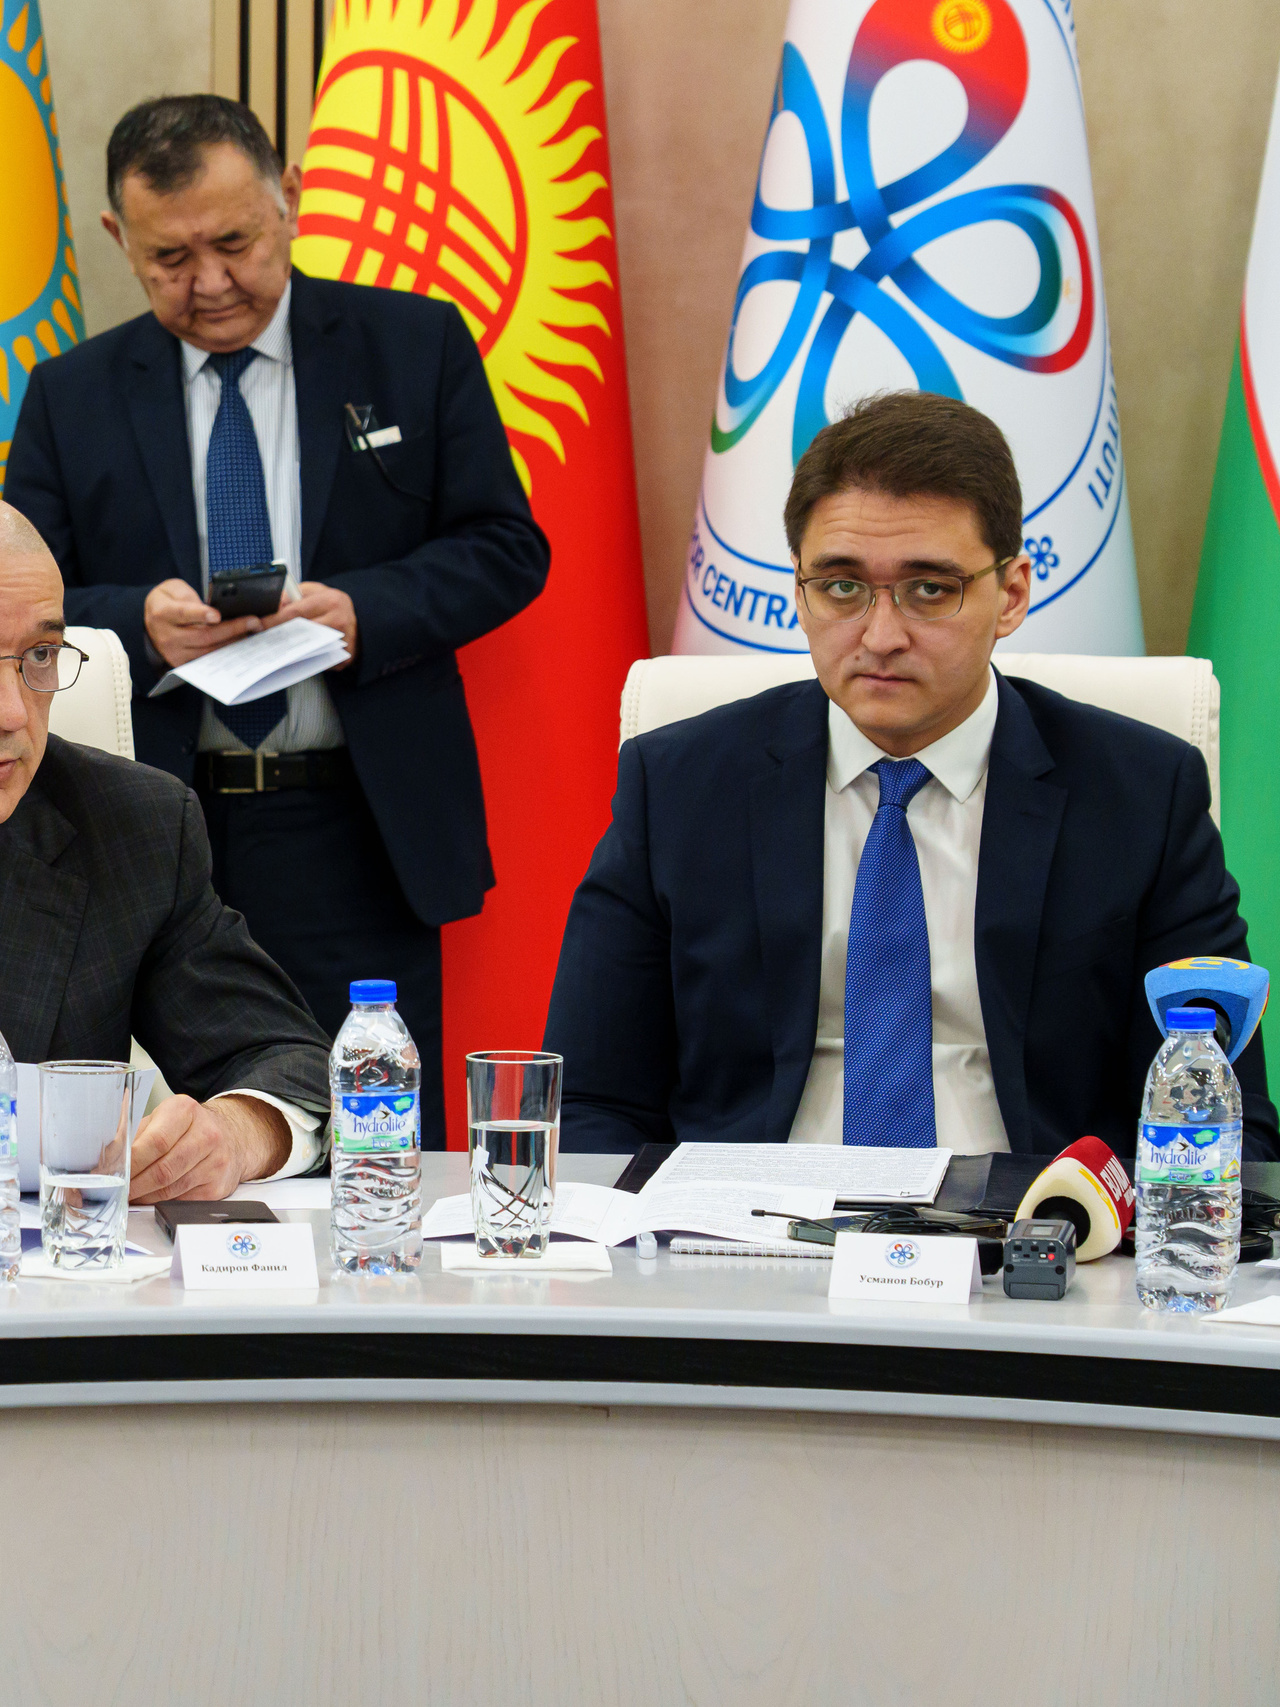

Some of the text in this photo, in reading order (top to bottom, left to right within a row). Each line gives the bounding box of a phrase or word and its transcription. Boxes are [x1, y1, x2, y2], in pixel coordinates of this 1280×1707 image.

[702, 563, 799, 630] CENTR
[353, 1116, 406, 1140] hydrolife
[1150, 1147, 1207, 1171] hydrolife
[201, 1263, 288, 1273] Кадиров Фанил
[860, 1274, 944, 1288] Усманов Бобур
